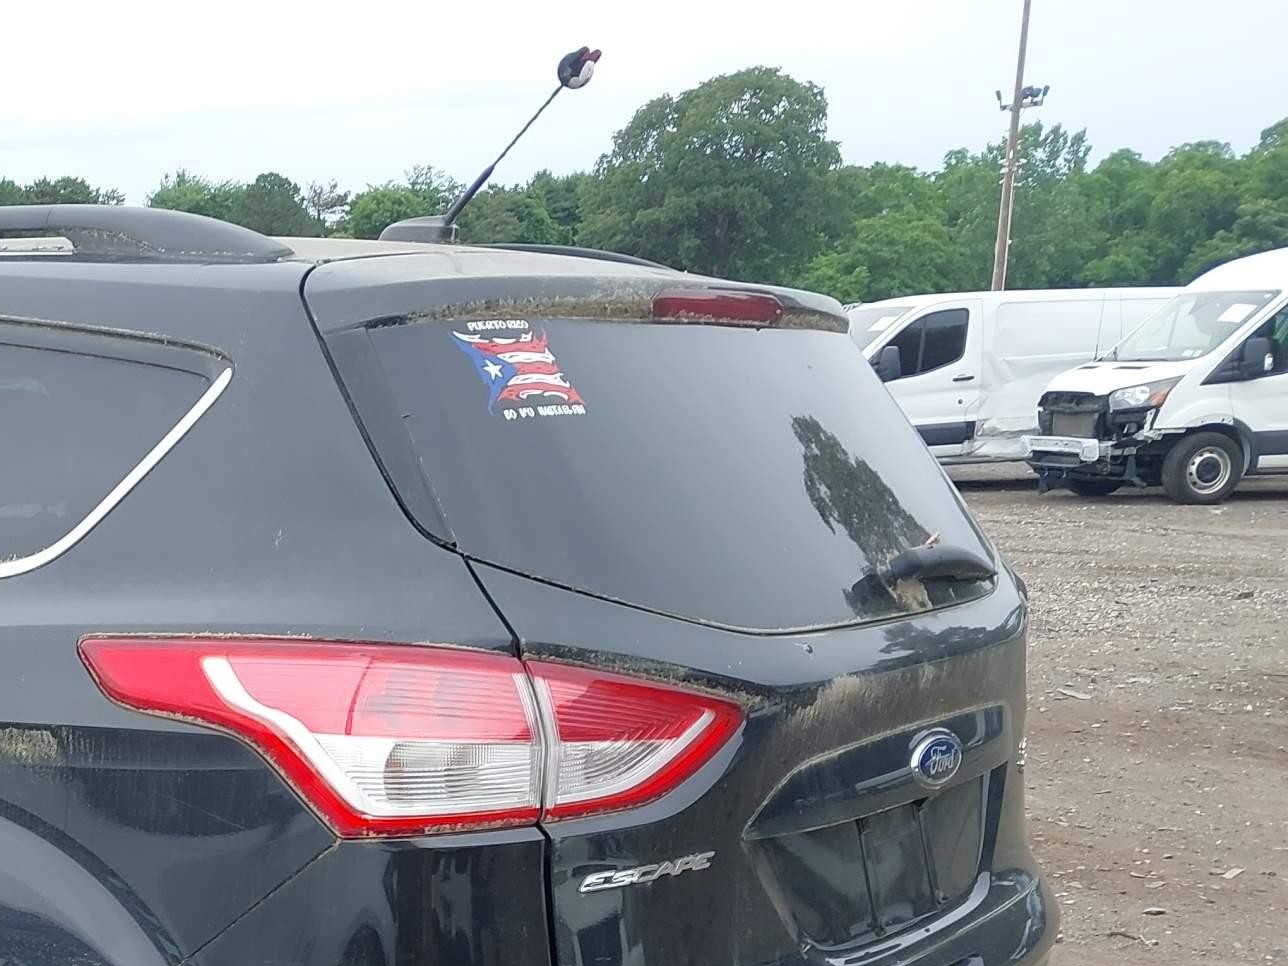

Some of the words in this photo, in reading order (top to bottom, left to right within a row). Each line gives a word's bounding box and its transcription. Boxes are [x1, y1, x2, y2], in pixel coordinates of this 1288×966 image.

[467, 319, 506, 332] PUERTO
[507, 319, 529, 329] RICO
[924, 745, 958, 775] Ford
[578, 851, 716, 893] ESCAPE
